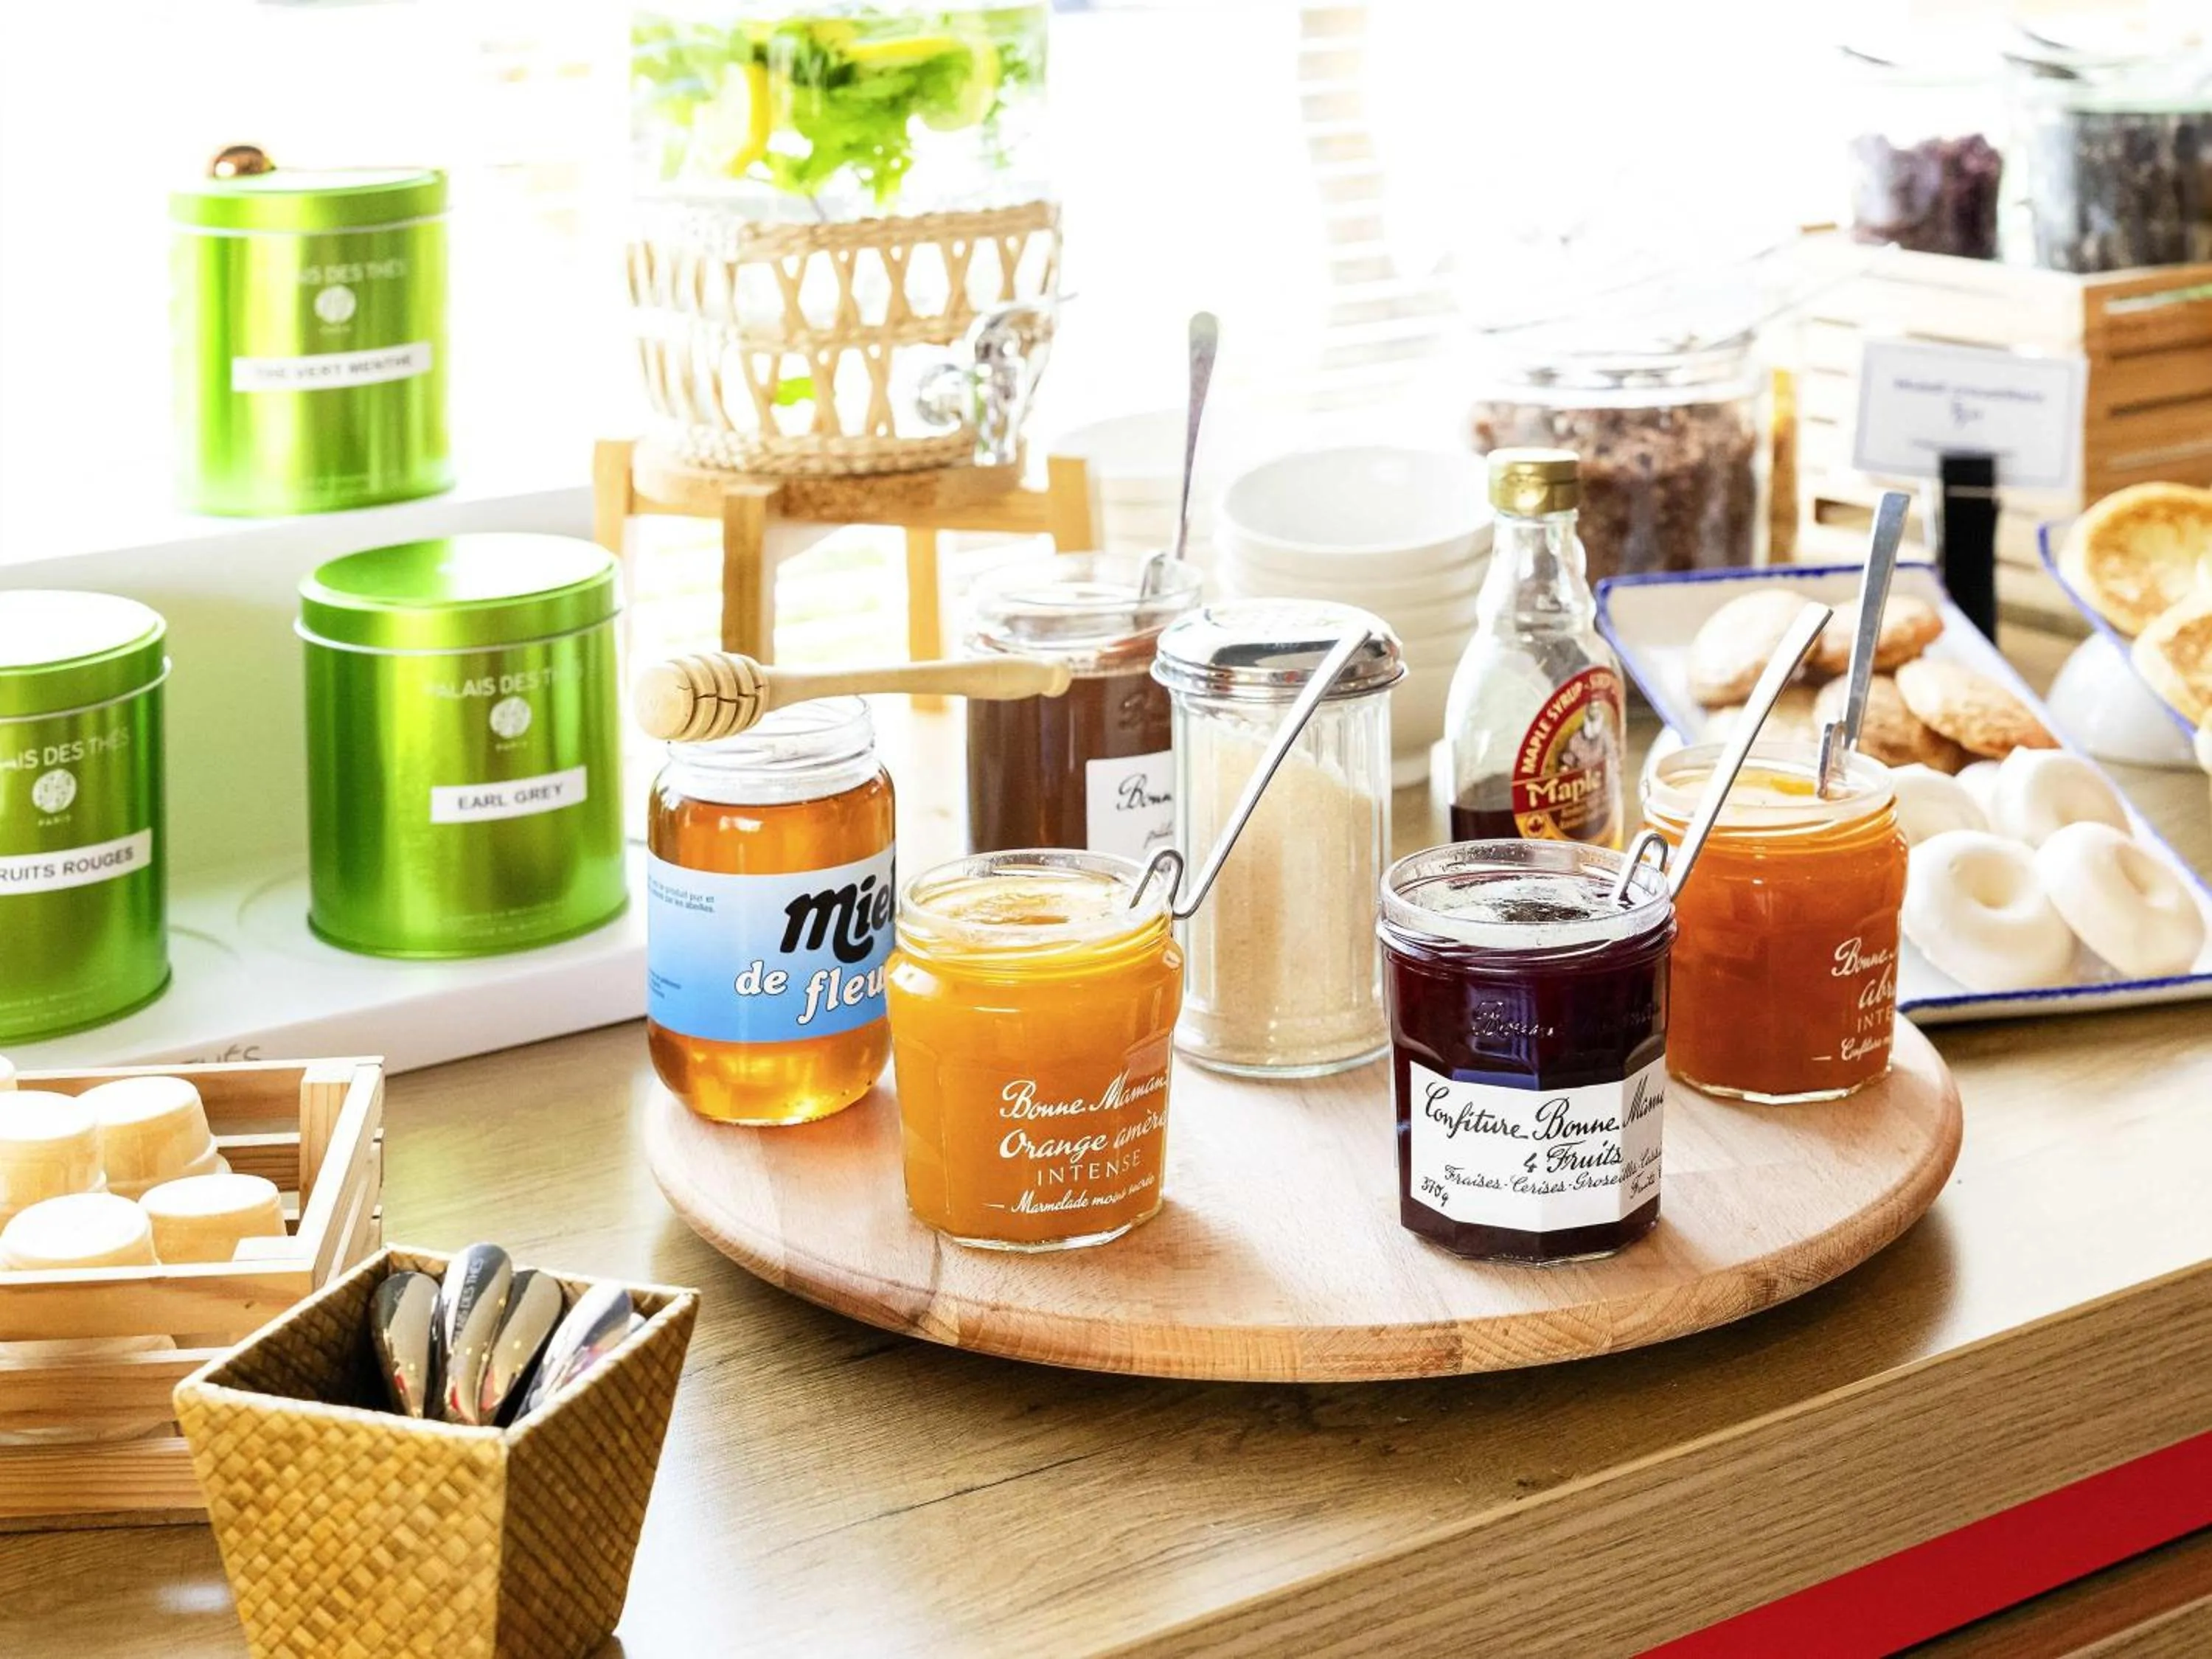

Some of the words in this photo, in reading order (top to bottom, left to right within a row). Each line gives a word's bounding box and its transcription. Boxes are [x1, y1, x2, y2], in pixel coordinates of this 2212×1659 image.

[498, 670, 540, 695] DES
[44, 740, 84, 766] DES
[1520, 717, 1551, 774] MAPLE
[457, 793, 509, 811] EARL
[514, 783, 563, 804] GREY
[63, 846, 134, 875] ROUGES
[734, 960, 789, 996] de
[999, 1079, 1086, 1120] Bonne
[1425, 1082, 1528, 1139] Confiture
[1532, 1096, 1620, 1141] Bonne
[999, 1129, 1108, 1164] Orange
[1523, 1152, 1537, 1173] 4
[1546, 1140, 1623, 1173] Fruits
[1037, 1148, 1142, 1186] INTENSE
